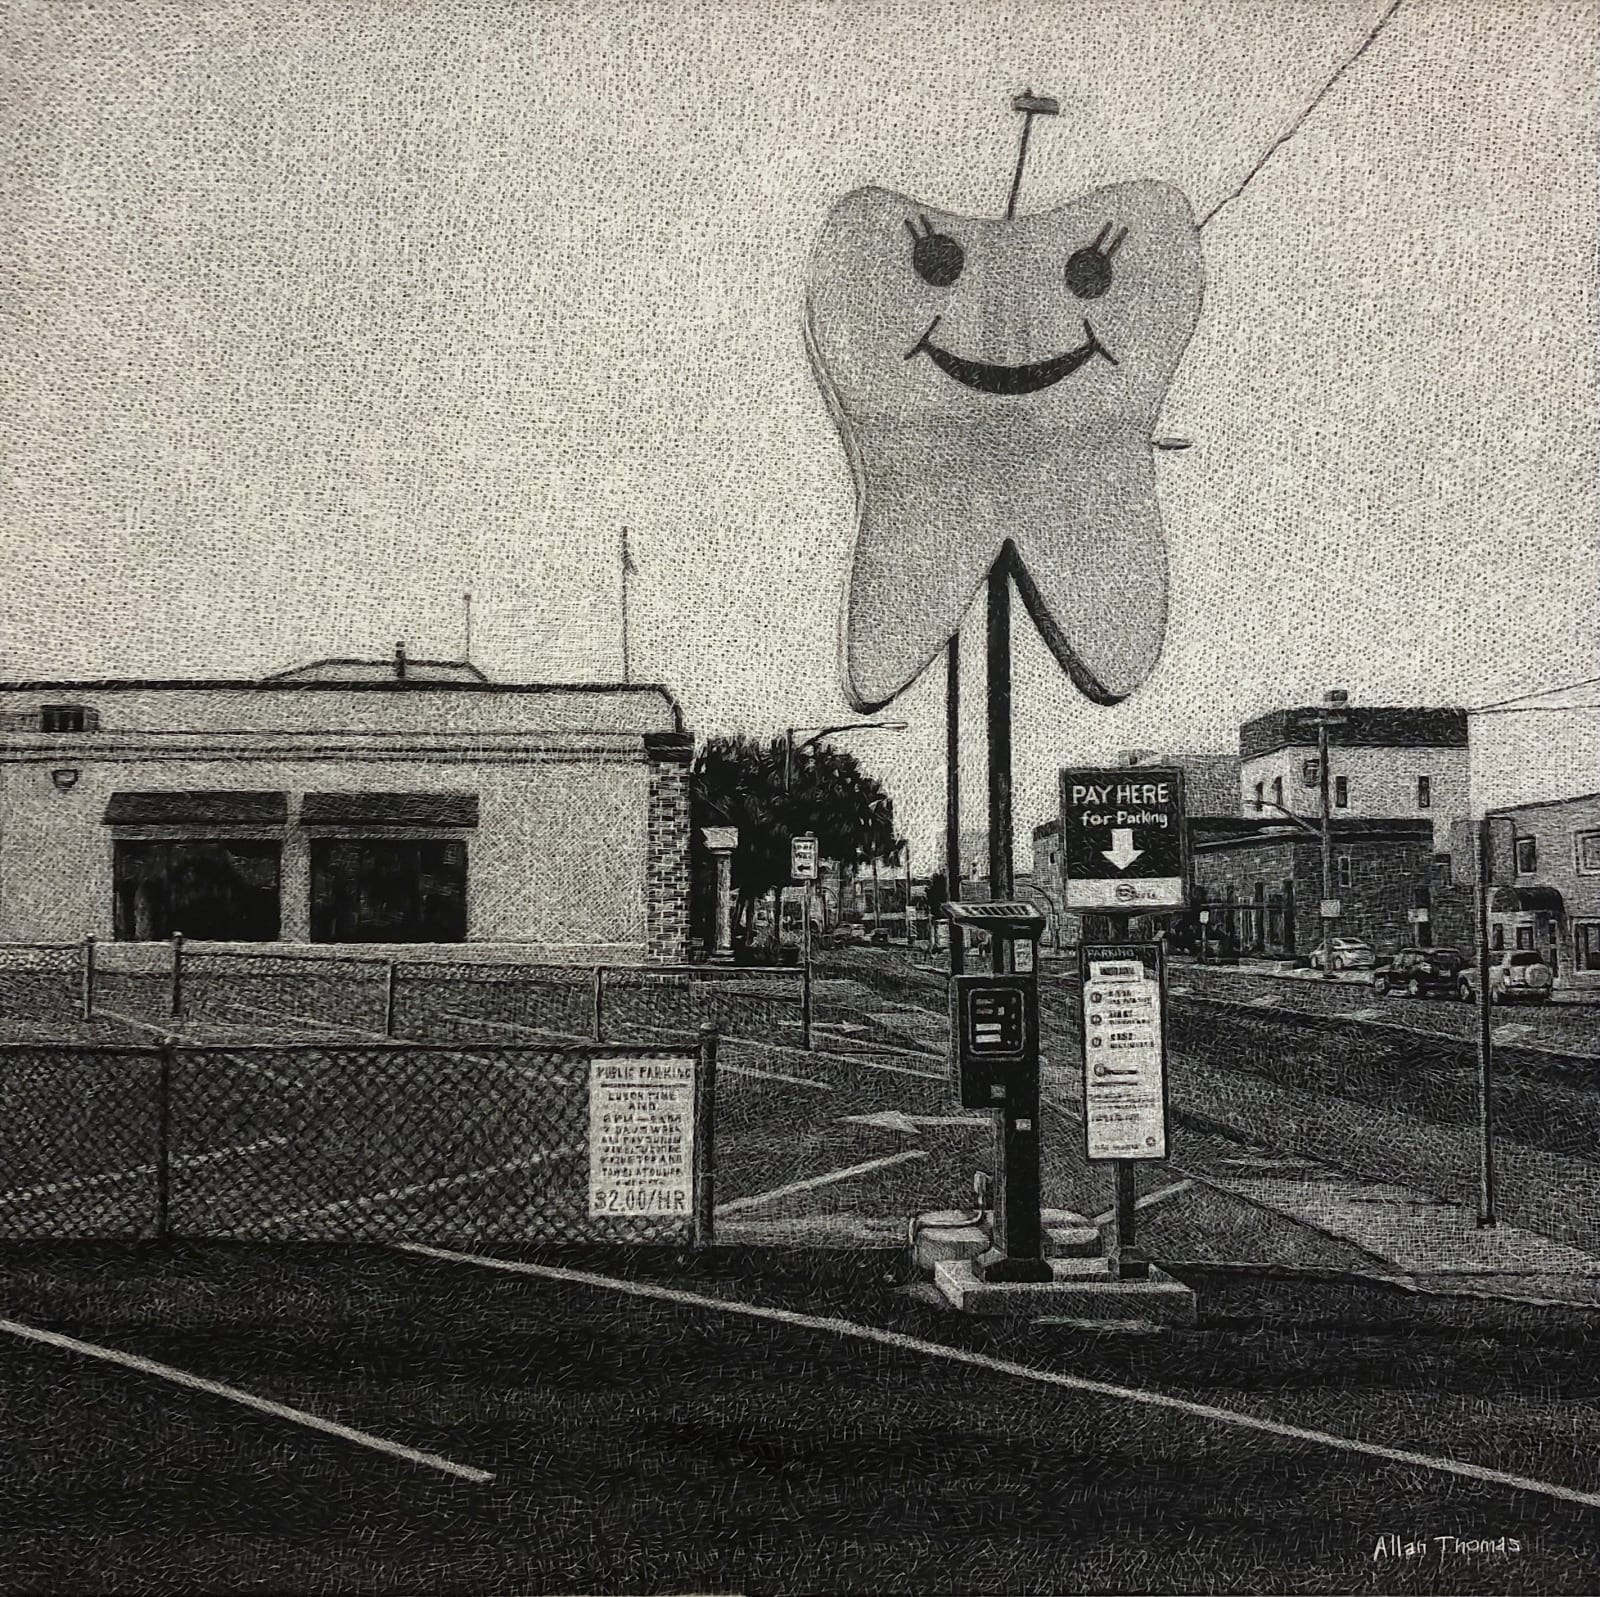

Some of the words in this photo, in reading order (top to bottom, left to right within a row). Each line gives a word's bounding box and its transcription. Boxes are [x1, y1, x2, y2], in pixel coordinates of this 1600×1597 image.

[1072, 784, 1114, 805] PAY
[1116, 783, 1169, 804] HERE
[1080, 810, 1112, 826] for
[1117, 810, 1168, 829] Parking
[596, 1066, 635, 1079] PUBLIC
[639, 1066, 691, 1079] PARKING
[1373, 1534, 1427, 1561] Allan
[1433, 1536, 1521, 1565] Thomas
